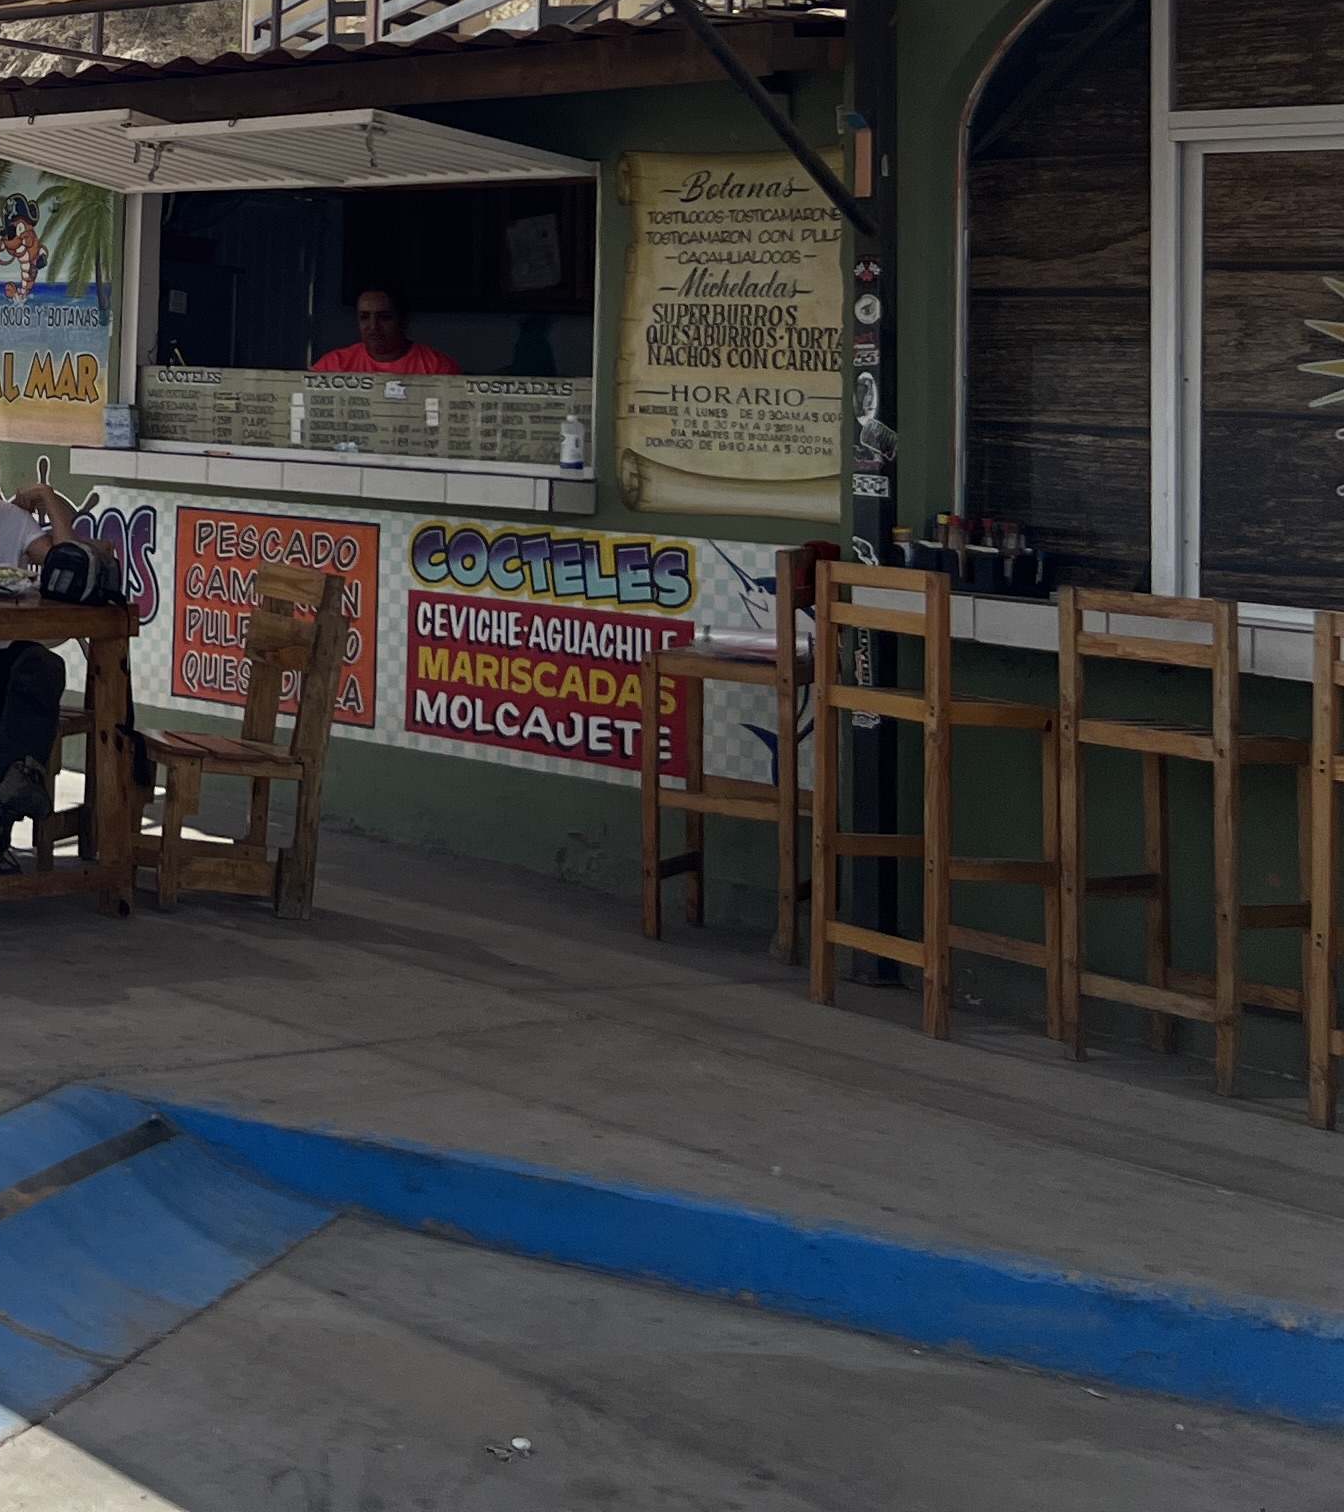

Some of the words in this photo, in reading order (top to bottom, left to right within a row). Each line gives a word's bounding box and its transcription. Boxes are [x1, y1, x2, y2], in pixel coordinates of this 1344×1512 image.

[679, 170, 798, 202] Botanas
[758, 229, 794, 245] CON
[676, 266, 800, 299] Micheladas
[35, 307, 44, 326] Y
[47, 308, 99, 328] BOTANAS
[648, 345, 721, 368] NACHOS
[727, 347, 768, 370] CON
[772, 349, 842, 372] CARNE
[23, 351, 100, 403] MAR
[157, 369, 223, 384] COCTELES
[303, 374, 374, 390] TACOS
[466, 379, 574, 396] TOSTADAS
[670, 384, 805, 407] HORARIO
[195, 520, 360, 571] PESCADO
[410, 525, 694, 609] COCTELES
[186, 562, 362, 619] CAMN
[417, 646, 677, 715] MARISCADAS
